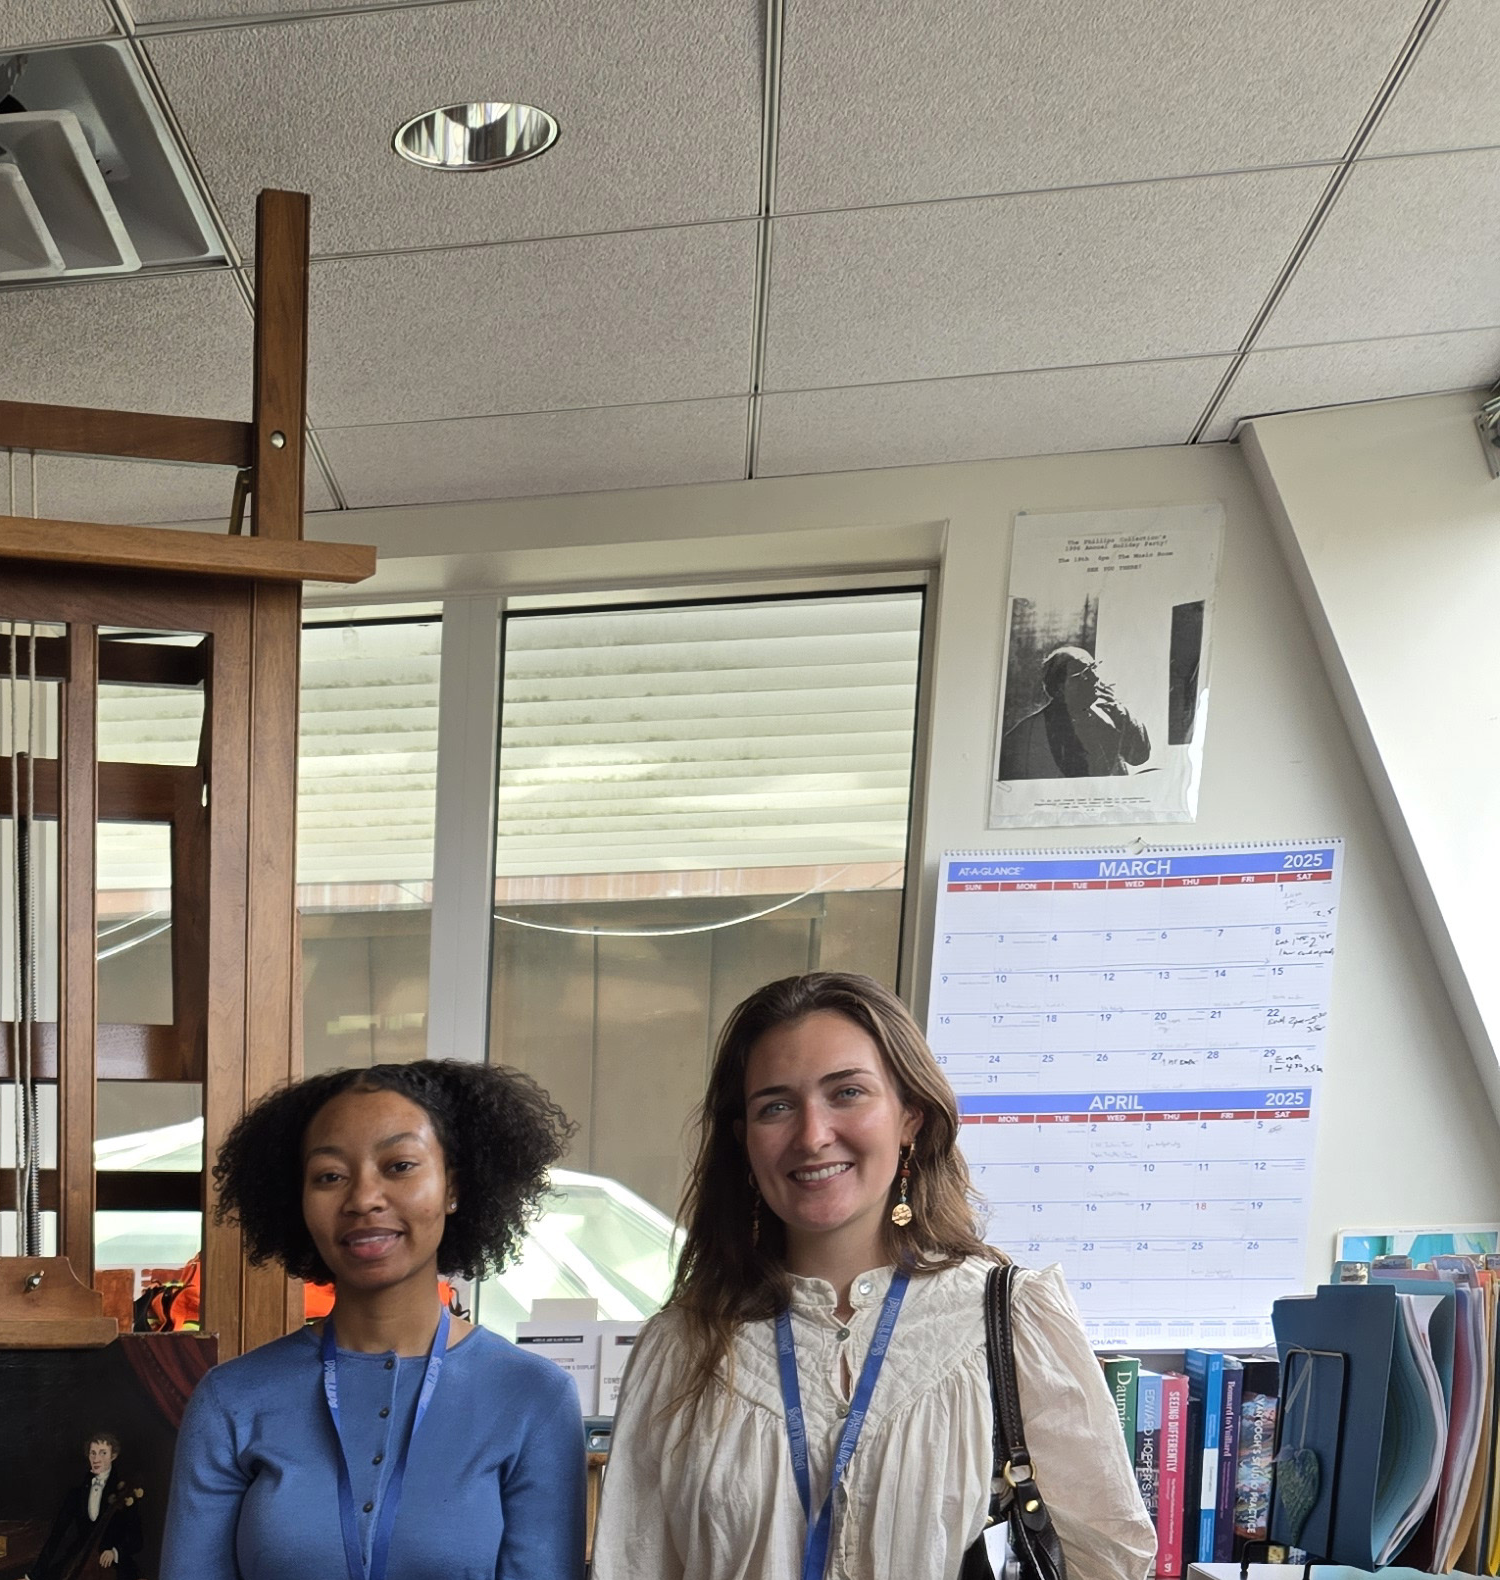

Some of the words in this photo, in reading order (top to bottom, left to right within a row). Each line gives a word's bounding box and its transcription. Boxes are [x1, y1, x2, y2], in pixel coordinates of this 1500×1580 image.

[1098, 861, 1171, 877] MARCH
[1282, 853, 1323, 868] 2025
[1182, 878, 1200, 886] THU
[945, 936, 951, 944] 2
[998, 935, 1004, 943] 3
[1052, 934, 1058, 942] 4
[1106, 933, 1112, 941] 5
[1218, 929, 1224, 937] 7
[1275, 927, 1281, 935] 8
[942, 976, 948, 984] 9
[996, 975, 1007, 983] 10
[1049, 974, 1059, 982] 11
[1104, 973, 1115, 981] 12
[1158, 972, 1170, 980] 13
[1215, 970, 1226, 978] 14
[940, 1017, 950, 1025] 16
[1046, 1015, 1057, 1023] 18
[1100, 1014, 1112, 1022] 19
[1155, 1012, 1167, 1021] 20
[1210, 1011, 1221, 1019] 21
[1267, 1009, 1280, 1017] 22
[936, 1056, 947, 1064] 23
[1042, 1055, 1054, 1063] 25
[1096, 1054, 1108, 1062] 26
[1151, 1053, 1163, 1061] 27
[1206, 1051, 1219, 1059] 28
[1263, 1049, 1276, 1058] 29
[987, 1075, 998, 1083] 31
[1088, 1095, 1143, 1110] APRIL
[1265, 1092, 1304, 1106] 2025
[998, 1115, 1019, 1123] MON
[1163, 1113, 1180, 1121] THU
[1037, 1125, 1042, 1133] 1
[1091, 1124, 1097, 1132] 2
[1146, 1123, 1152, 1131] 3
[1200, 1122, 1207, 1130] 4
[1257, 1121, 1264, 1129] 5
[981, 1166, 986, 1174] 7
[1088, 1165, 1094, 1173] 9
[1143, 1164, 1155, 1172] 10
[1198, 1163, 1209, 1171] 11
[1254, 1162, 1266, 1170] 12
[1028, 1243, 1040, 1251] 22
[1082, 1243, 1094, 1251] 23
[1136, 1242, 1148, 1250] 24
[1191, 1242, 1203, 1250] 25
[1247, 1241, 1259, 1249] 26
[1079, 1281, 1092, 1290] 30
[871, 1296, 899, 1357] PHILLIPS
[1168, 1391, 1180, 1420] SEEING
[1226, 1380, 1236, 1416] Bonnard
[1254, 1397, 1265, 1418] VAN
[1144, 1388, 1156, 1437] EDWARD
[1224, 1416, 1233, 1425] to
[836, 1410, 864, 1473] PHILLIPS
[1223, 1424, 1233, 1457] Vuillard
[1251, 1419, 1263, 1455] GOGH'S
[1166, 1421, 1179, 1473] DIFFERENTLY
[1141, 1438, 1154, 1491] HOPPER'S
[1250, 1456, 1260, 1490] STUDIO
[1247, 1491, 1259, 1534] PRACTICE
